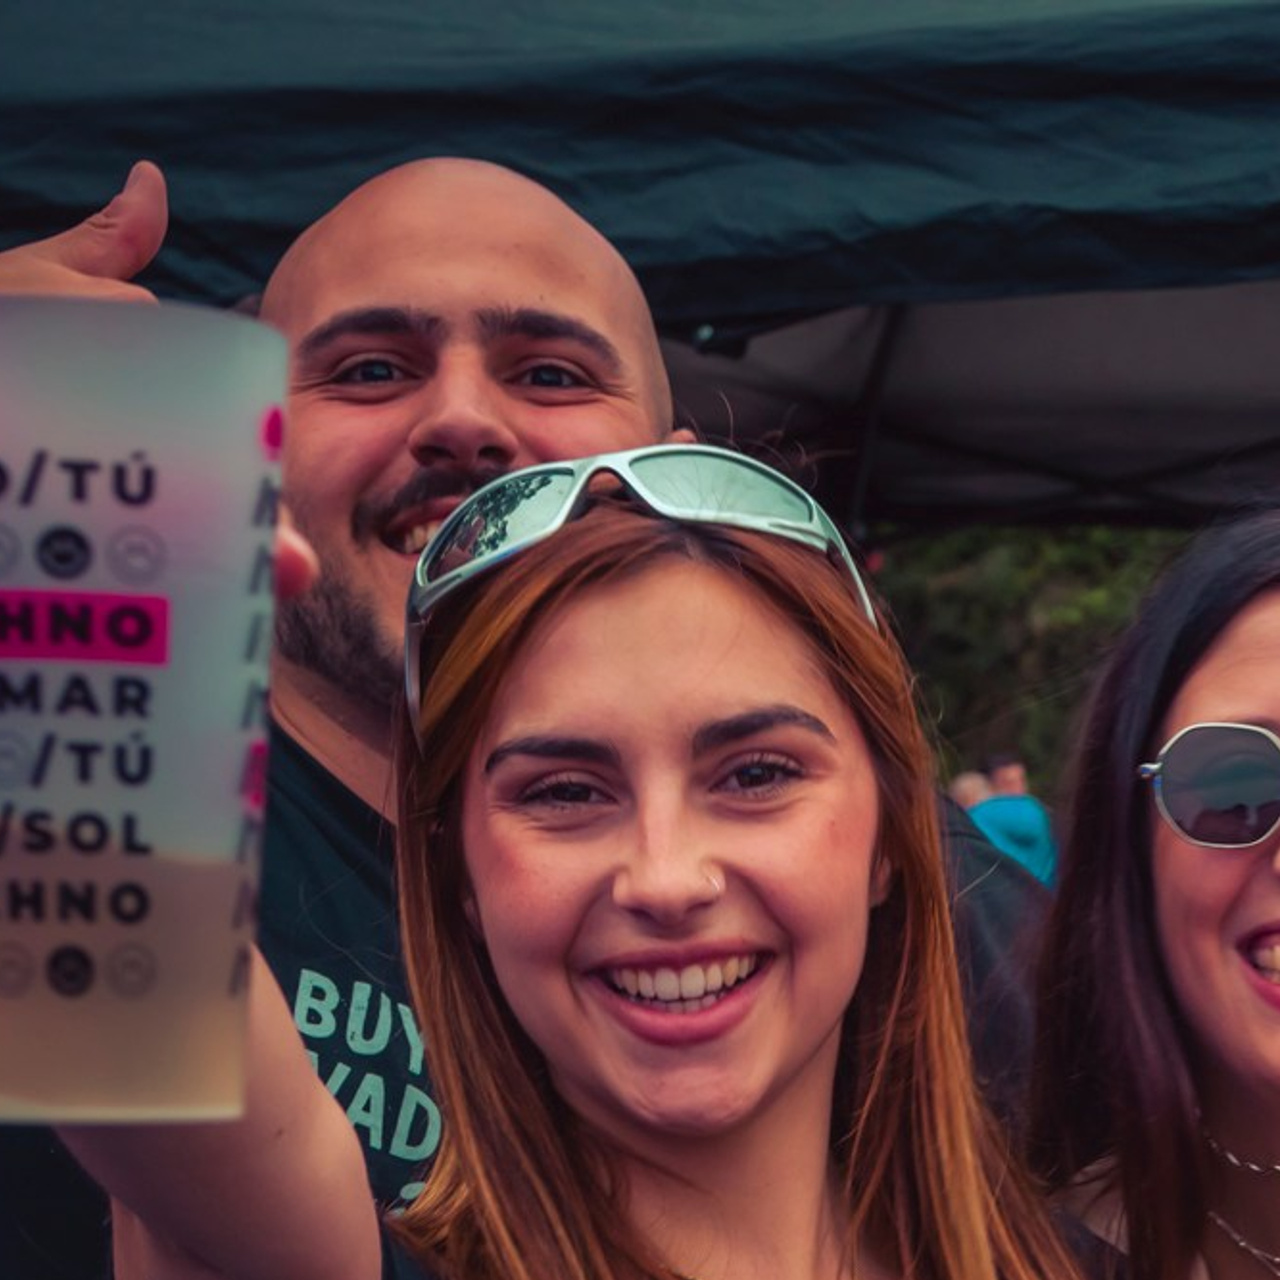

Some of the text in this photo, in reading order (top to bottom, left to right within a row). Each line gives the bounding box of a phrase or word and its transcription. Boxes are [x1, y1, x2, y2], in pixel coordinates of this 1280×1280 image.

[0, 450, 156, 508] /TÚ
[6, 880, 152, 924] HNO
[294, 968, 425, 1076] BUY
